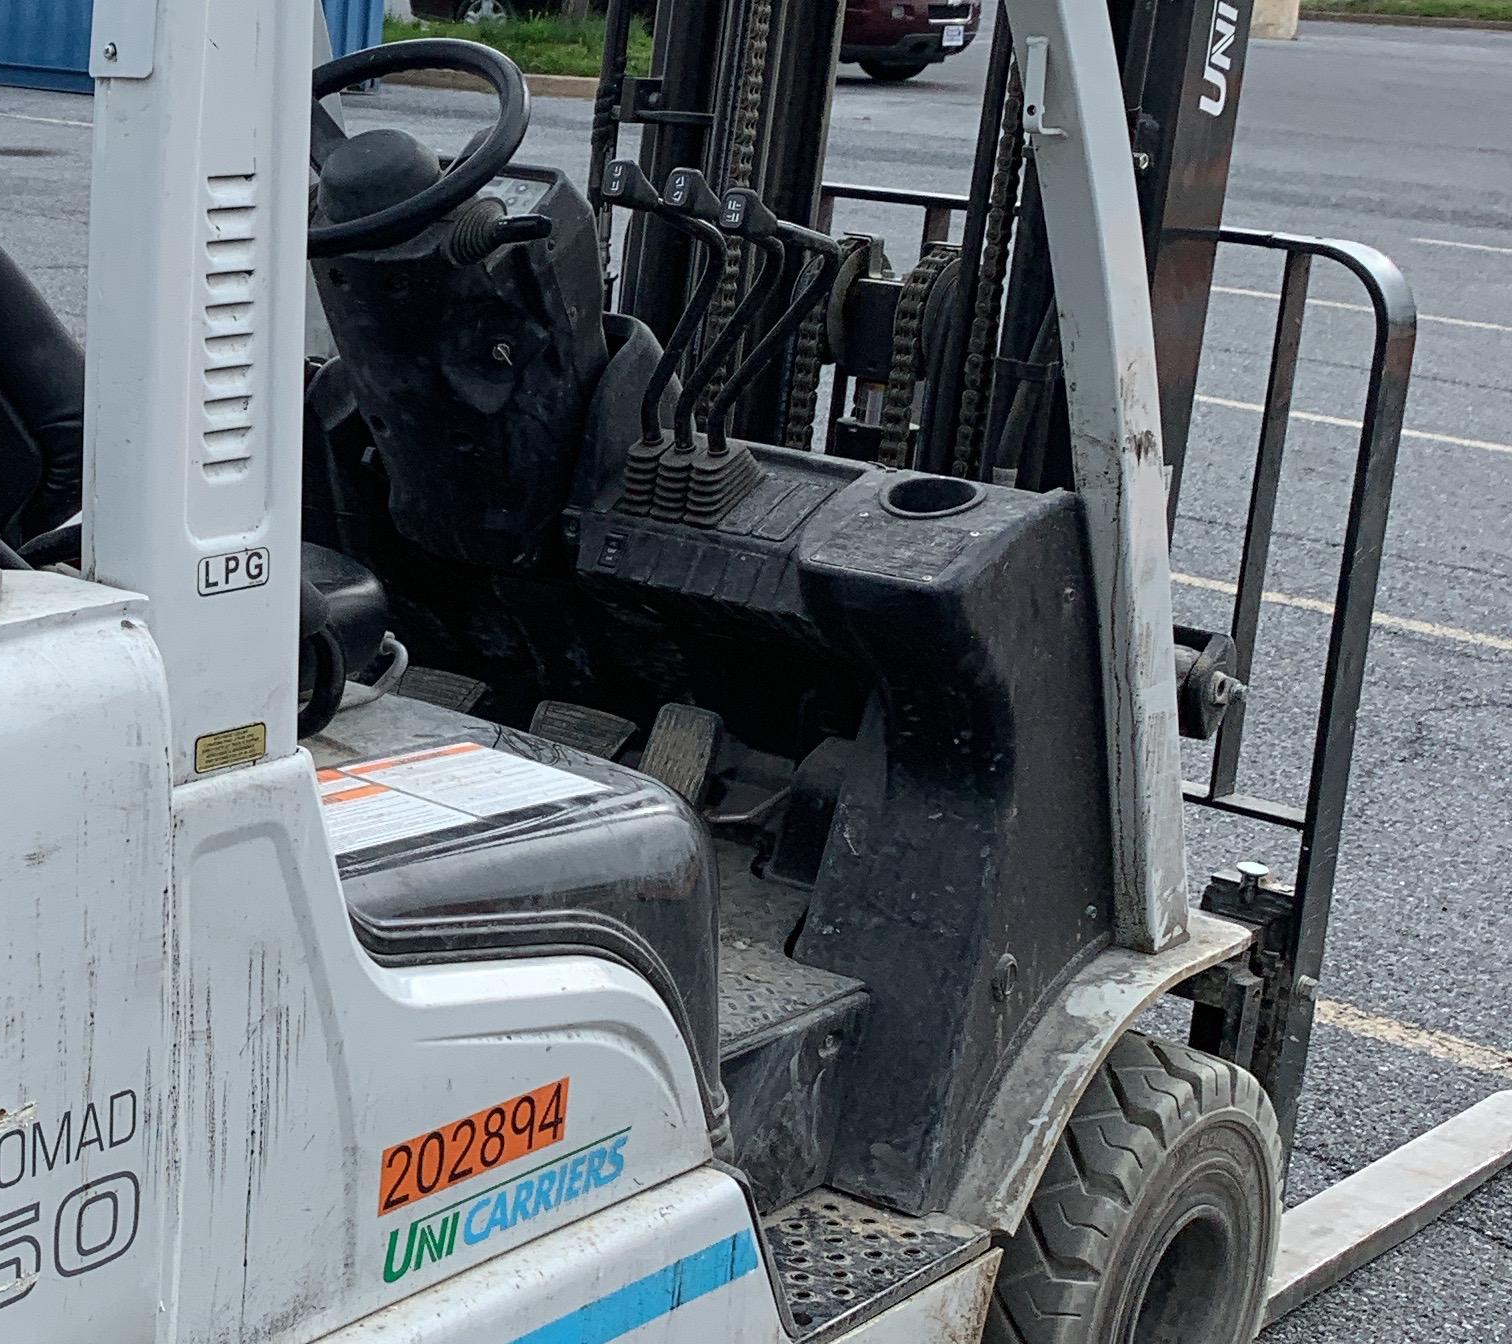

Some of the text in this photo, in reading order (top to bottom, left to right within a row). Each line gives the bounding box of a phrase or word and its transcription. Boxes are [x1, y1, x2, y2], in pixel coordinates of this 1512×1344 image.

[204, 551, 263, 589] LPG
[382, 1082, 563, 1212] 202894
[382, 1130, 630, 1284] UNICARRIERS
